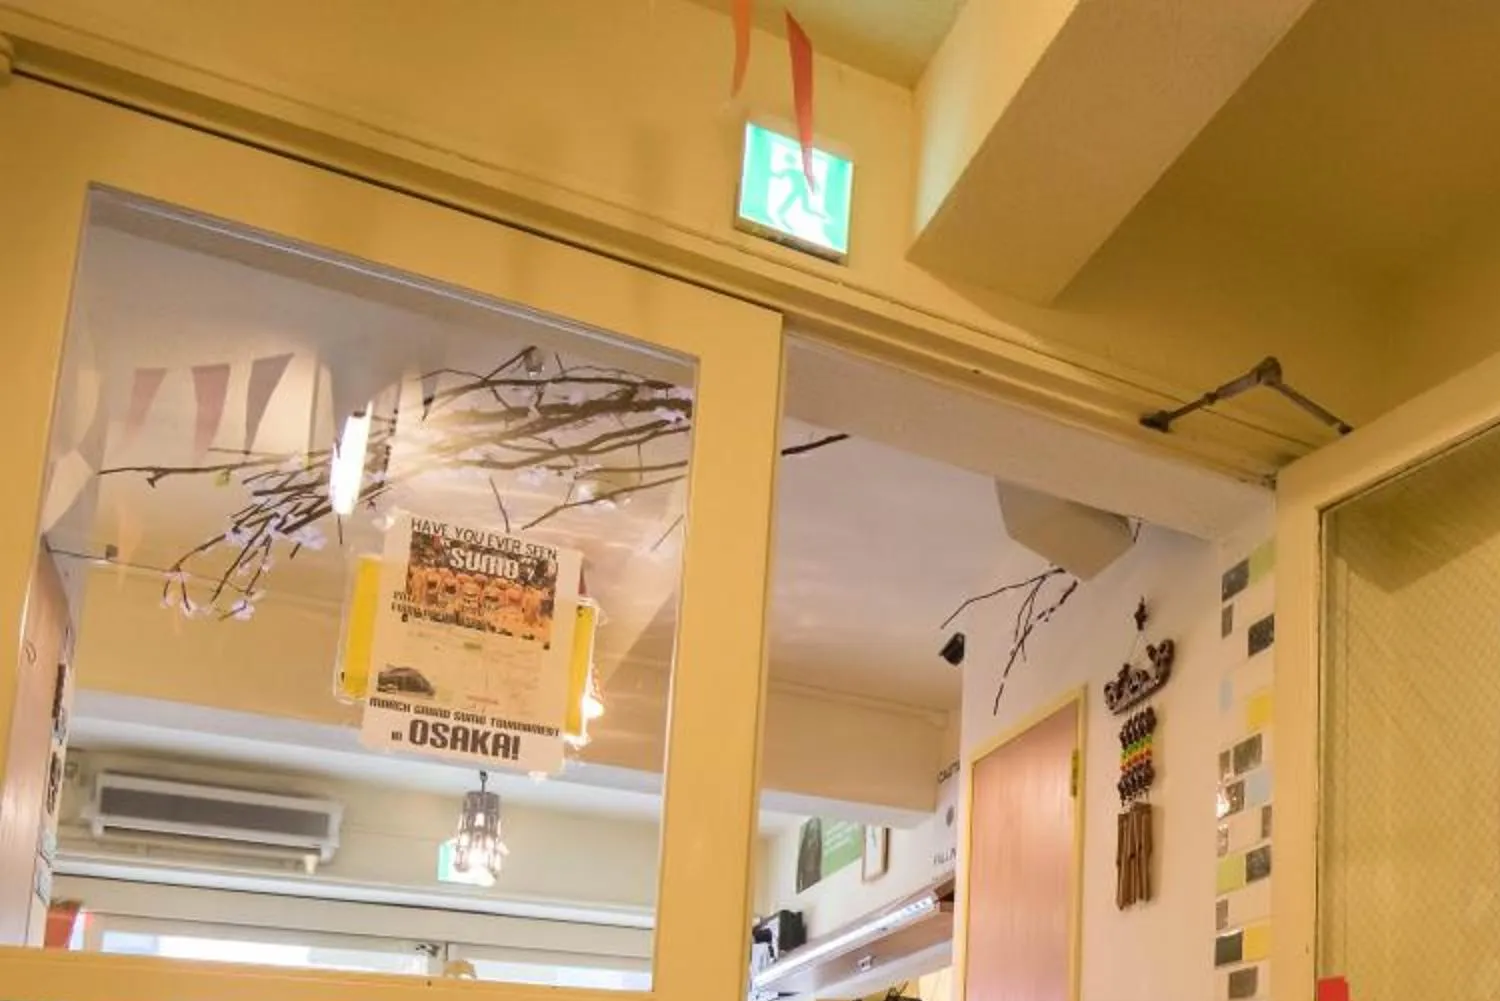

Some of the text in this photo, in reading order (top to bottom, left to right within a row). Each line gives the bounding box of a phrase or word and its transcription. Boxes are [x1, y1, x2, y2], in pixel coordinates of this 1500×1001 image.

[411, 517, 558, 560] HAVE YOU EVER SEEN
[409, 719, 521, 760] OSAKA!
